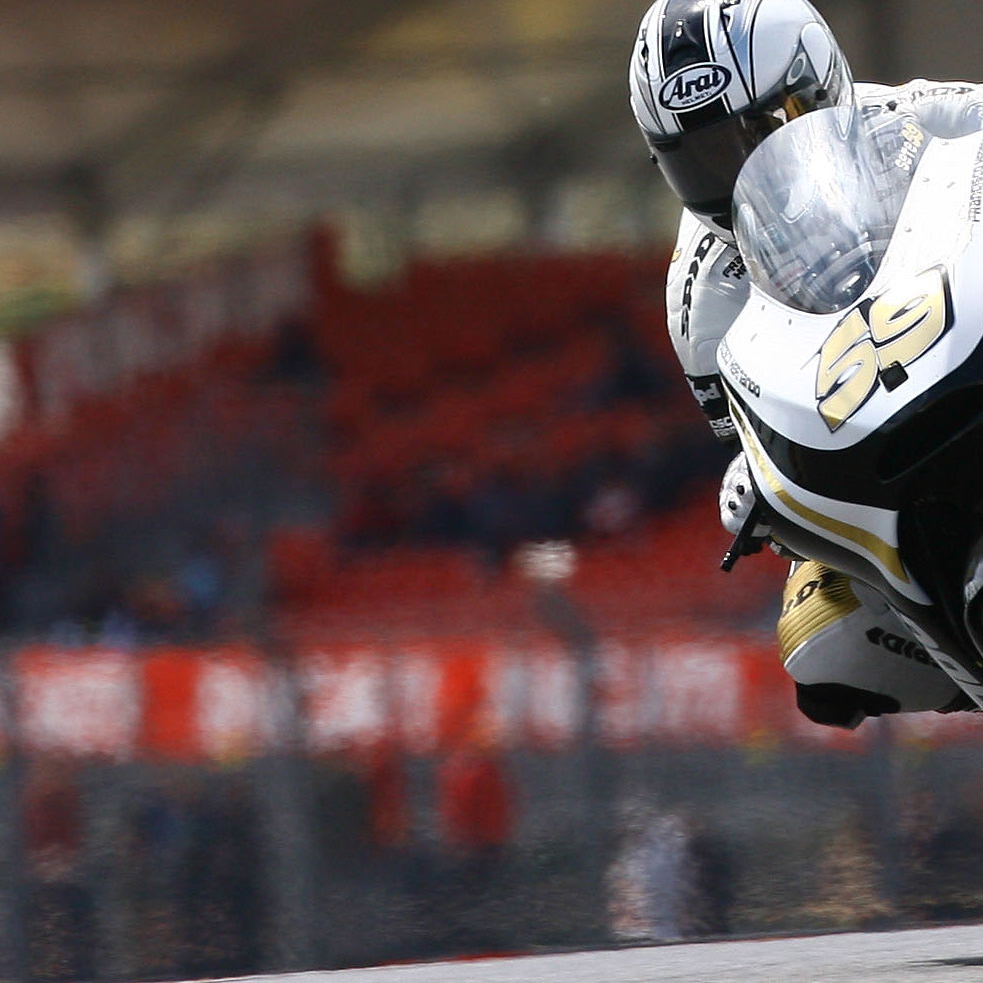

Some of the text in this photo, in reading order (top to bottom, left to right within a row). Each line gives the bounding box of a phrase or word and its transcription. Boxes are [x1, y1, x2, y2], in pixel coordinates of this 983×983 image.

[667, 67, 721, 104] Arai
[681, 231, 716, 341] SPID
[815, 264, 955, 434] 59
